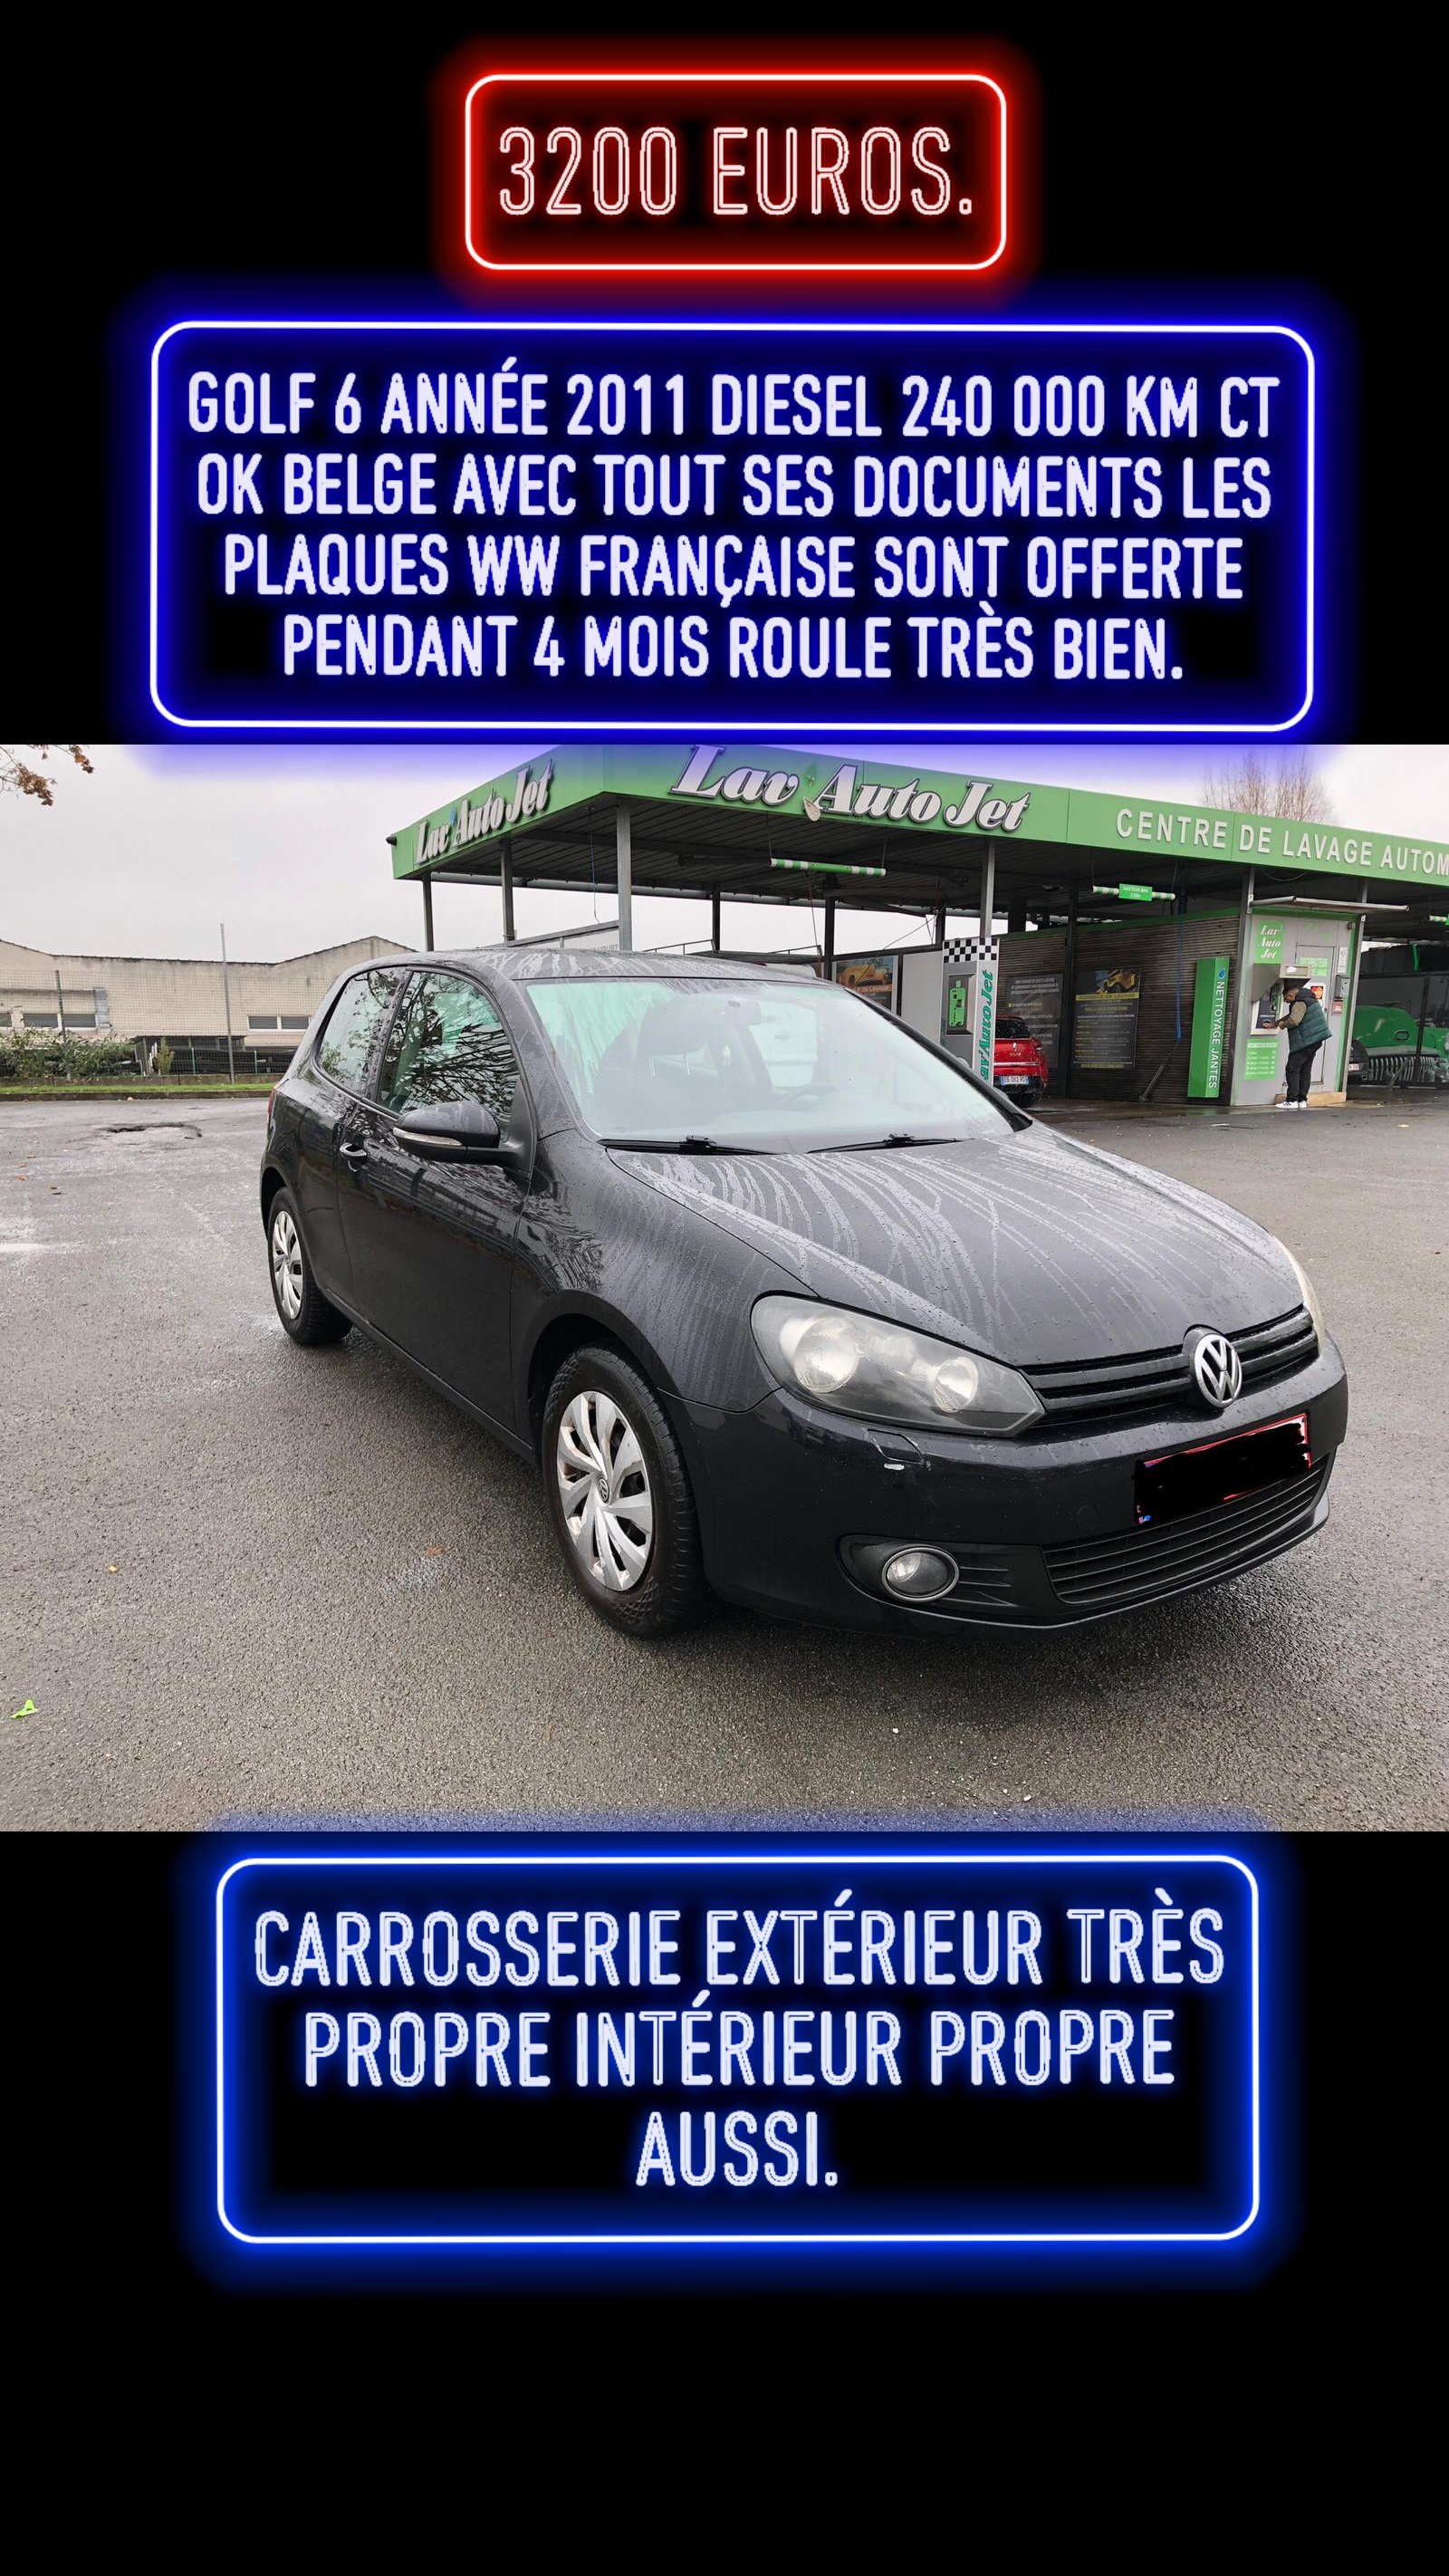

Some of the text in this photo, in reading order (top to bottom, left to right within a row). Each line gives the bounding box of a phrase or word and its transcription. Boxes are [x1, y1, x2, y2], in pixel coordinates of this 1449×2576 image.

[505, 757, 553, 823] Jet
[668, 745, 1032, 832] Lav Auto Jet
[1116, 808, 1228, 849] CENTRE
[1239, 824, 1272, 854] DE
[1282, 830, 1373, 867] LAVAGE
[1258, 937, 1281, 947] Auto
[1260, 948, 1277, 959] Jet
[981, 969, 993, 1005] Jet
[1208, 981, 1225, 1089] NETTOYAGE JANTES
